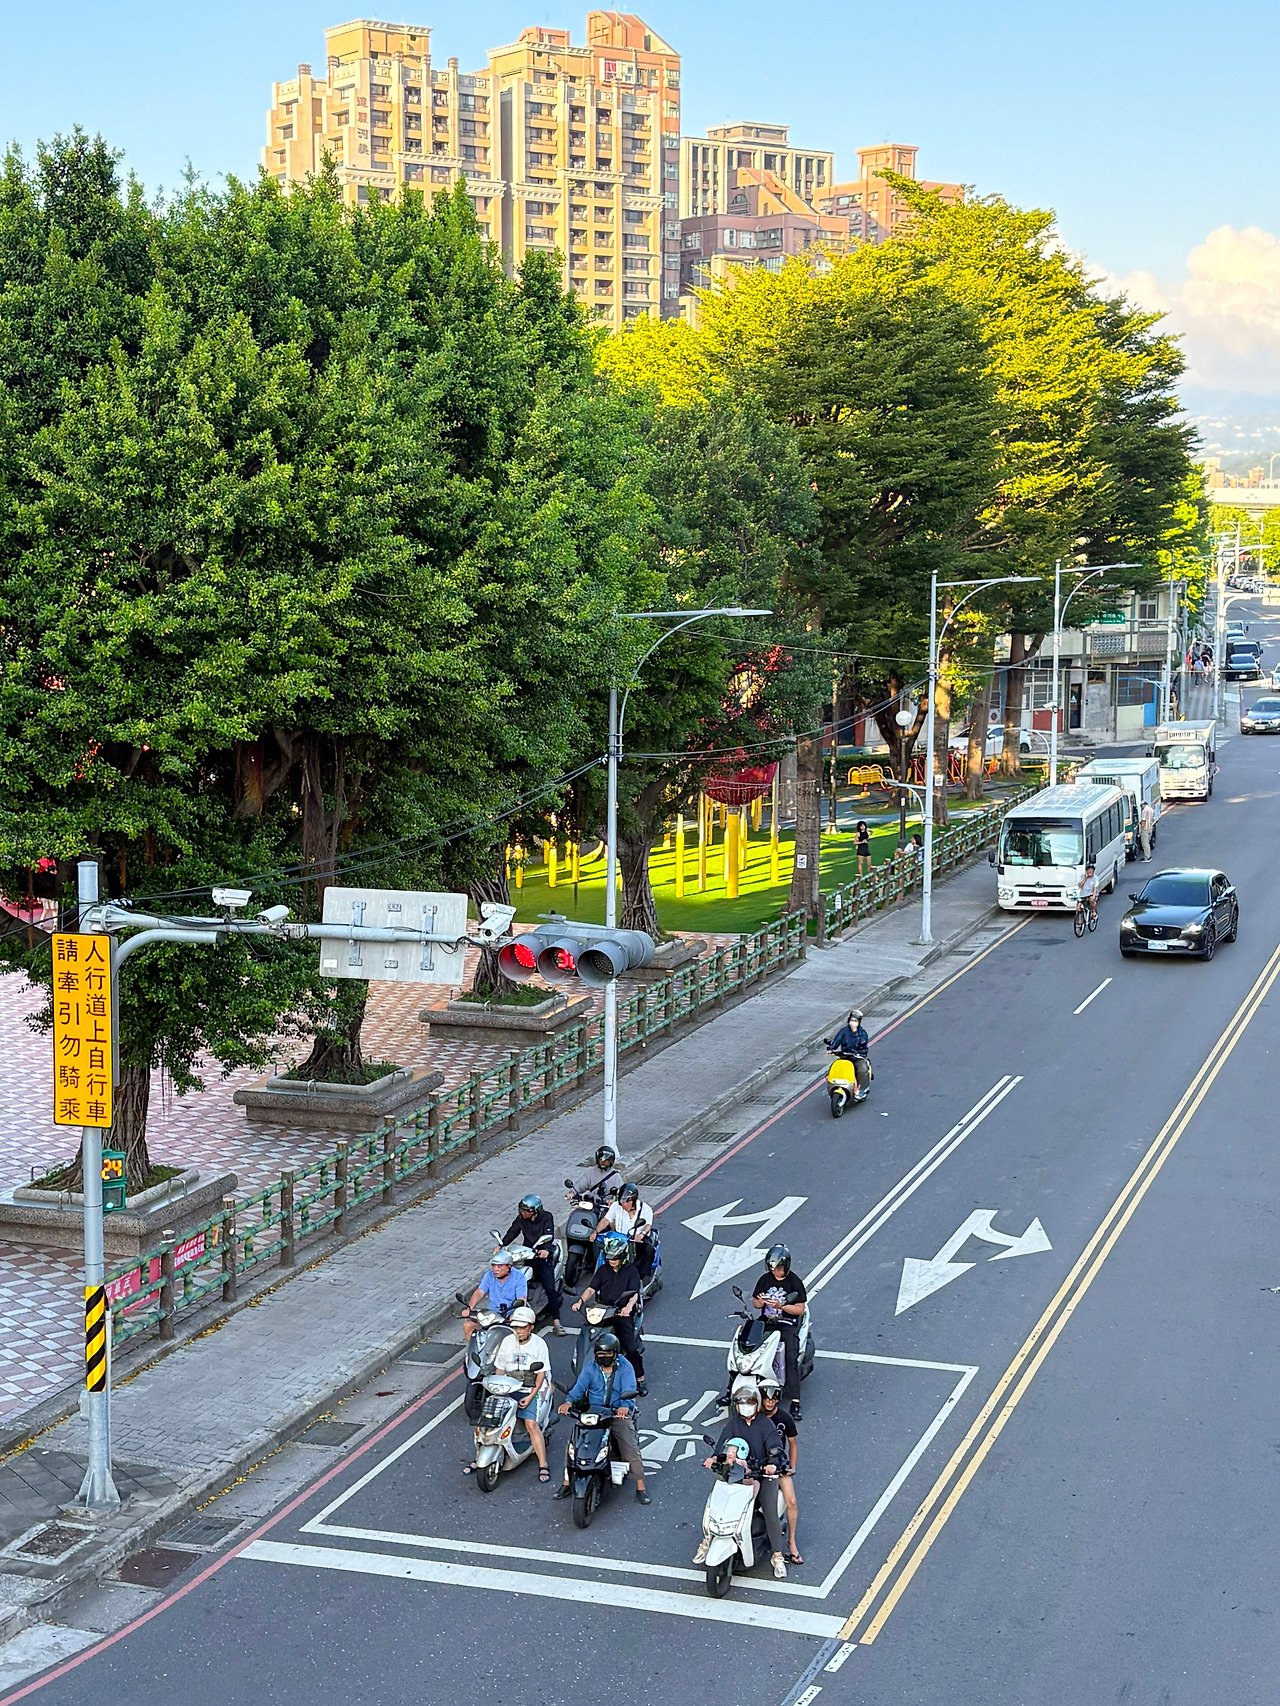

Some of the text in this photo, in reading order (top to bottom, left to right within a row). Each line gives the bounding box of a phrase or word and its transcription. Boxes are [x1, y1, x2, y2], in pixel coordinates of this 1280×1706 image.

[57, 939, 81, 1120] 請牽引勿騎乘
[85, 940, 107, 1122] 人行道上自行車
[101, 1158, 122, 1180] 24
